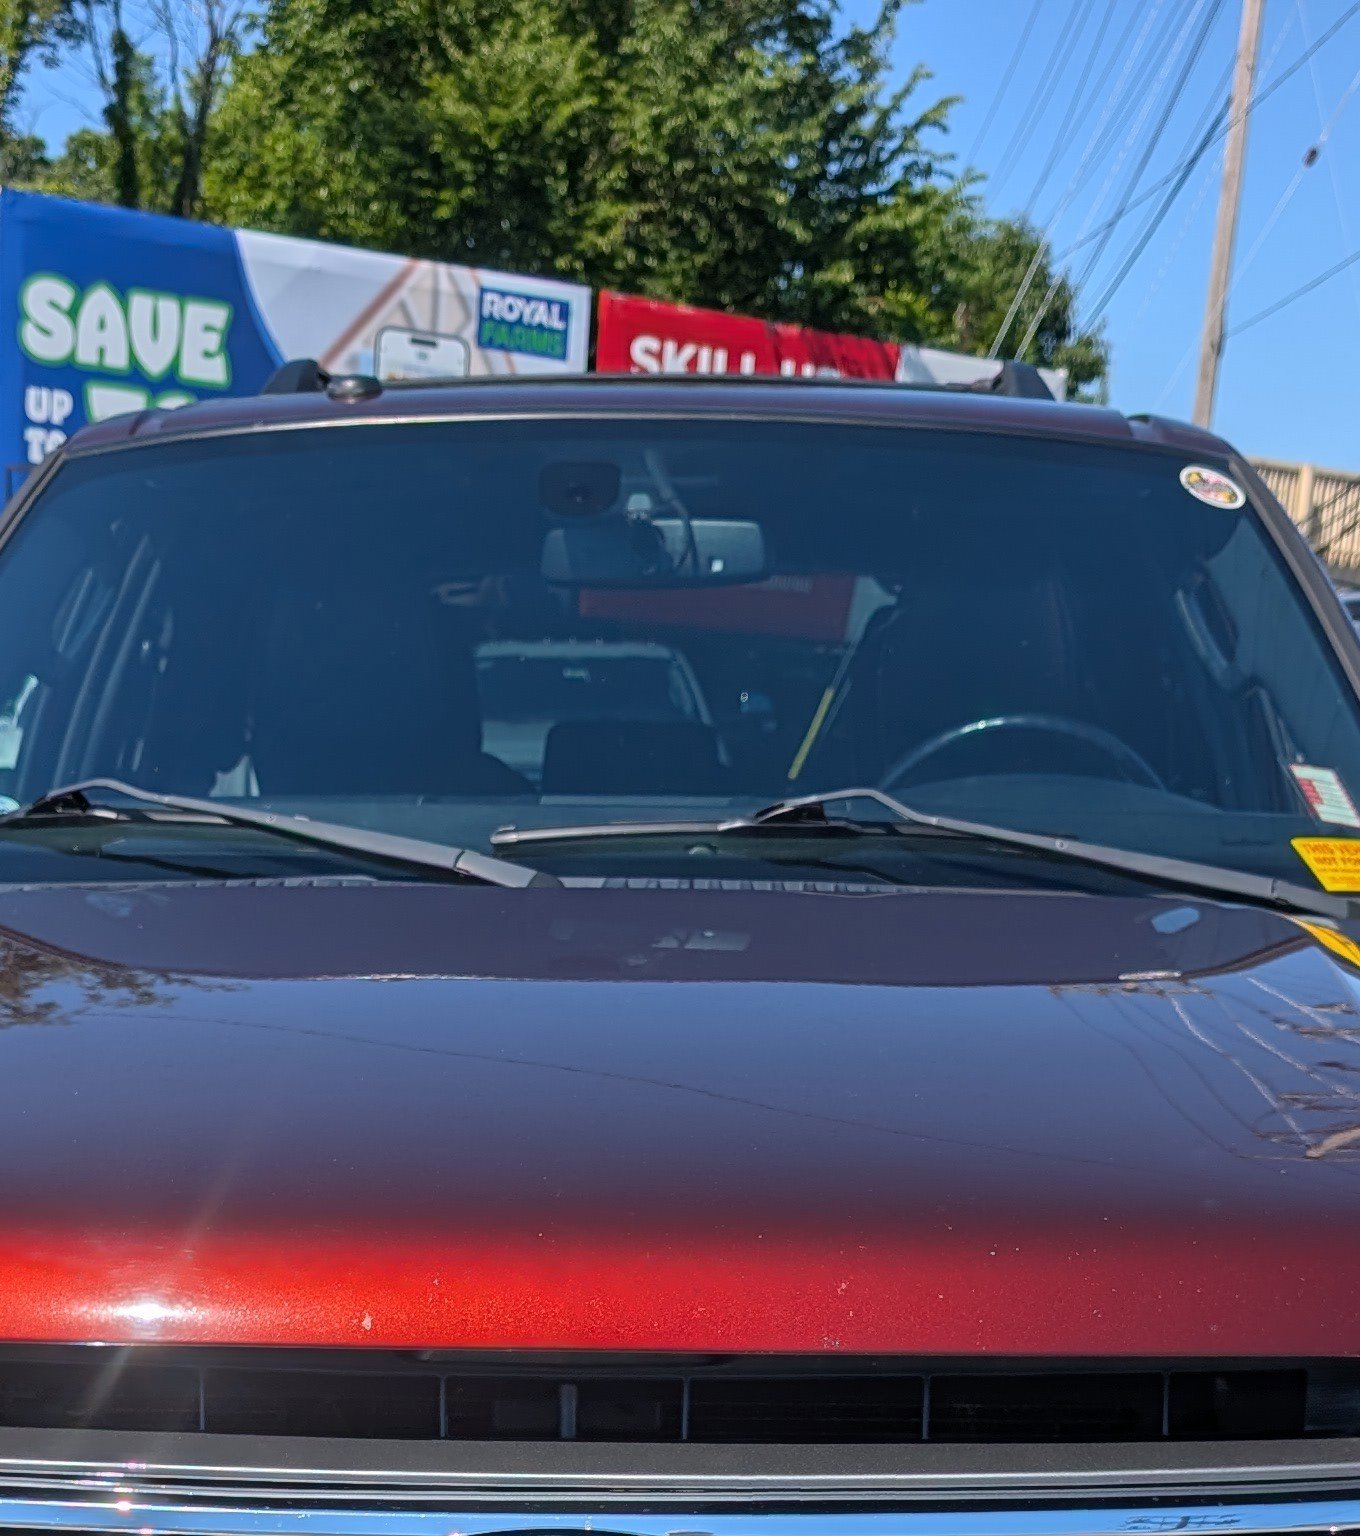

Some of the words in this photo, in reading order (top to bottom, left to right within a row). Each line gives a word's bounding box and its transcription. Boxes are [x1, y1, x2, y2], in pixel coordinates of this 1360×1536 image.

[20, 275, 231, 387] SAVE
[482, 292, 565, 330] ROYAL
[24, 385, 74, 426] UP
